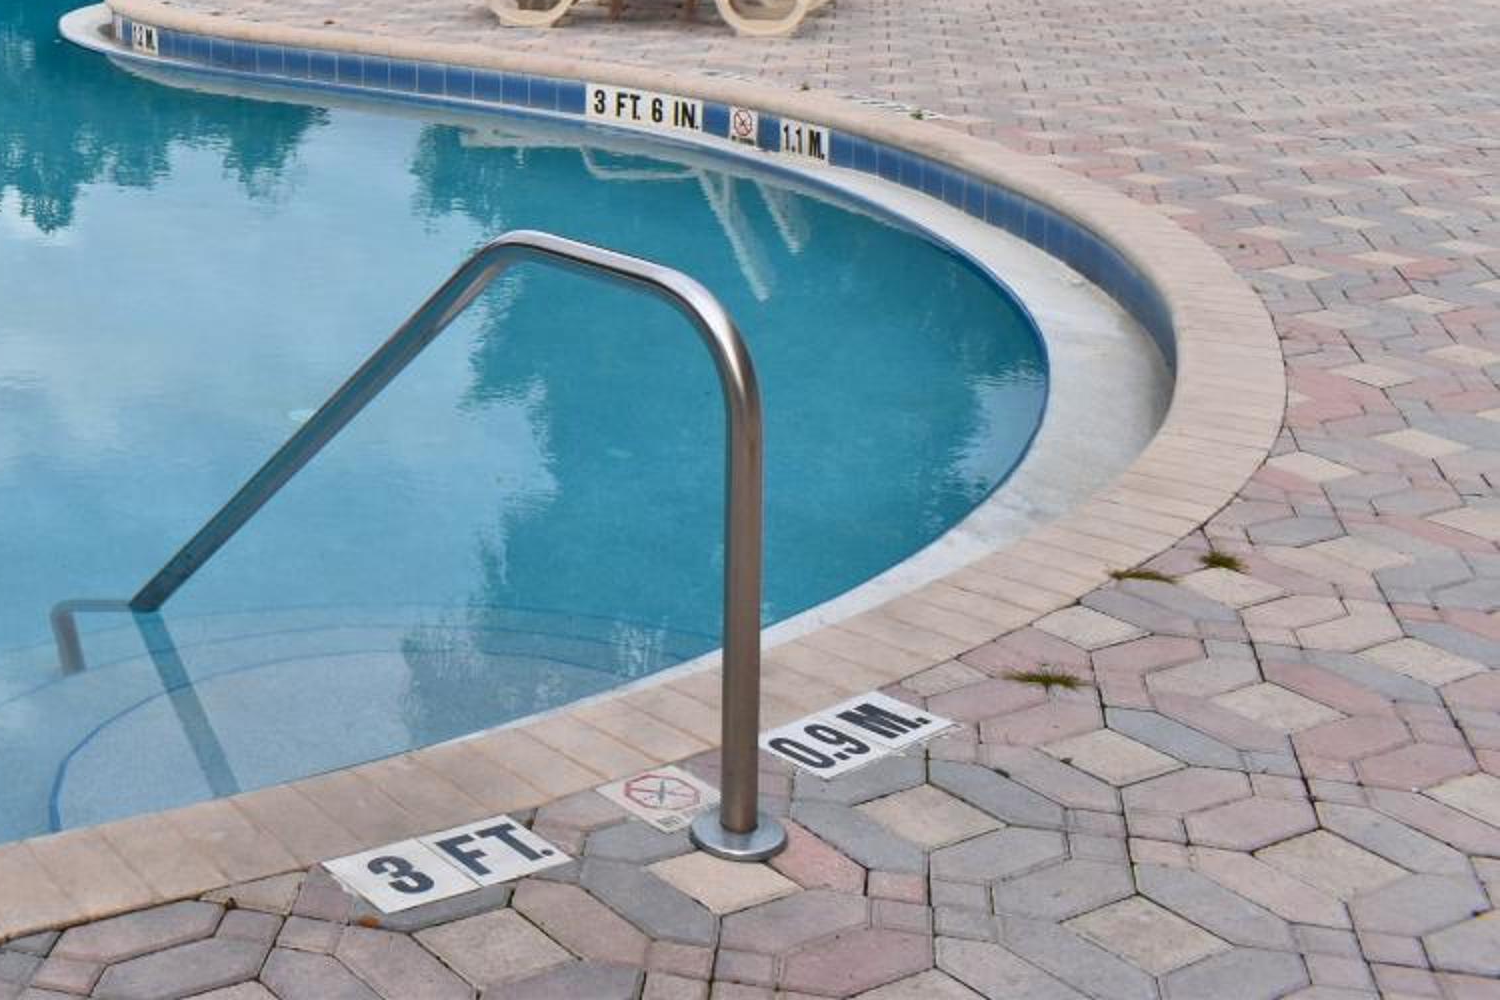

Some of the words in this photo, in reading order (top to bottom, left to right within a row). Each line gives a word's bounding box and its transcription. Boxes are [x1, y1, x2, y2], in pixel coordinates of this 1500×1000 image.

[594, 89, 606, 114] 3
[616, 92, 641, 120] FT.
[651, 97, 663, 122] 6
[673, 101, 698, 130] IN.
[783, 123, 802, 154] 1.1
[808, 129, 825, 160] M.
[768, 724, 870, 768] 0.9
[835, 703, 932, 739] M.
[367, 855, 435, 894] 3
[433, 823, 555, 876] FT.
